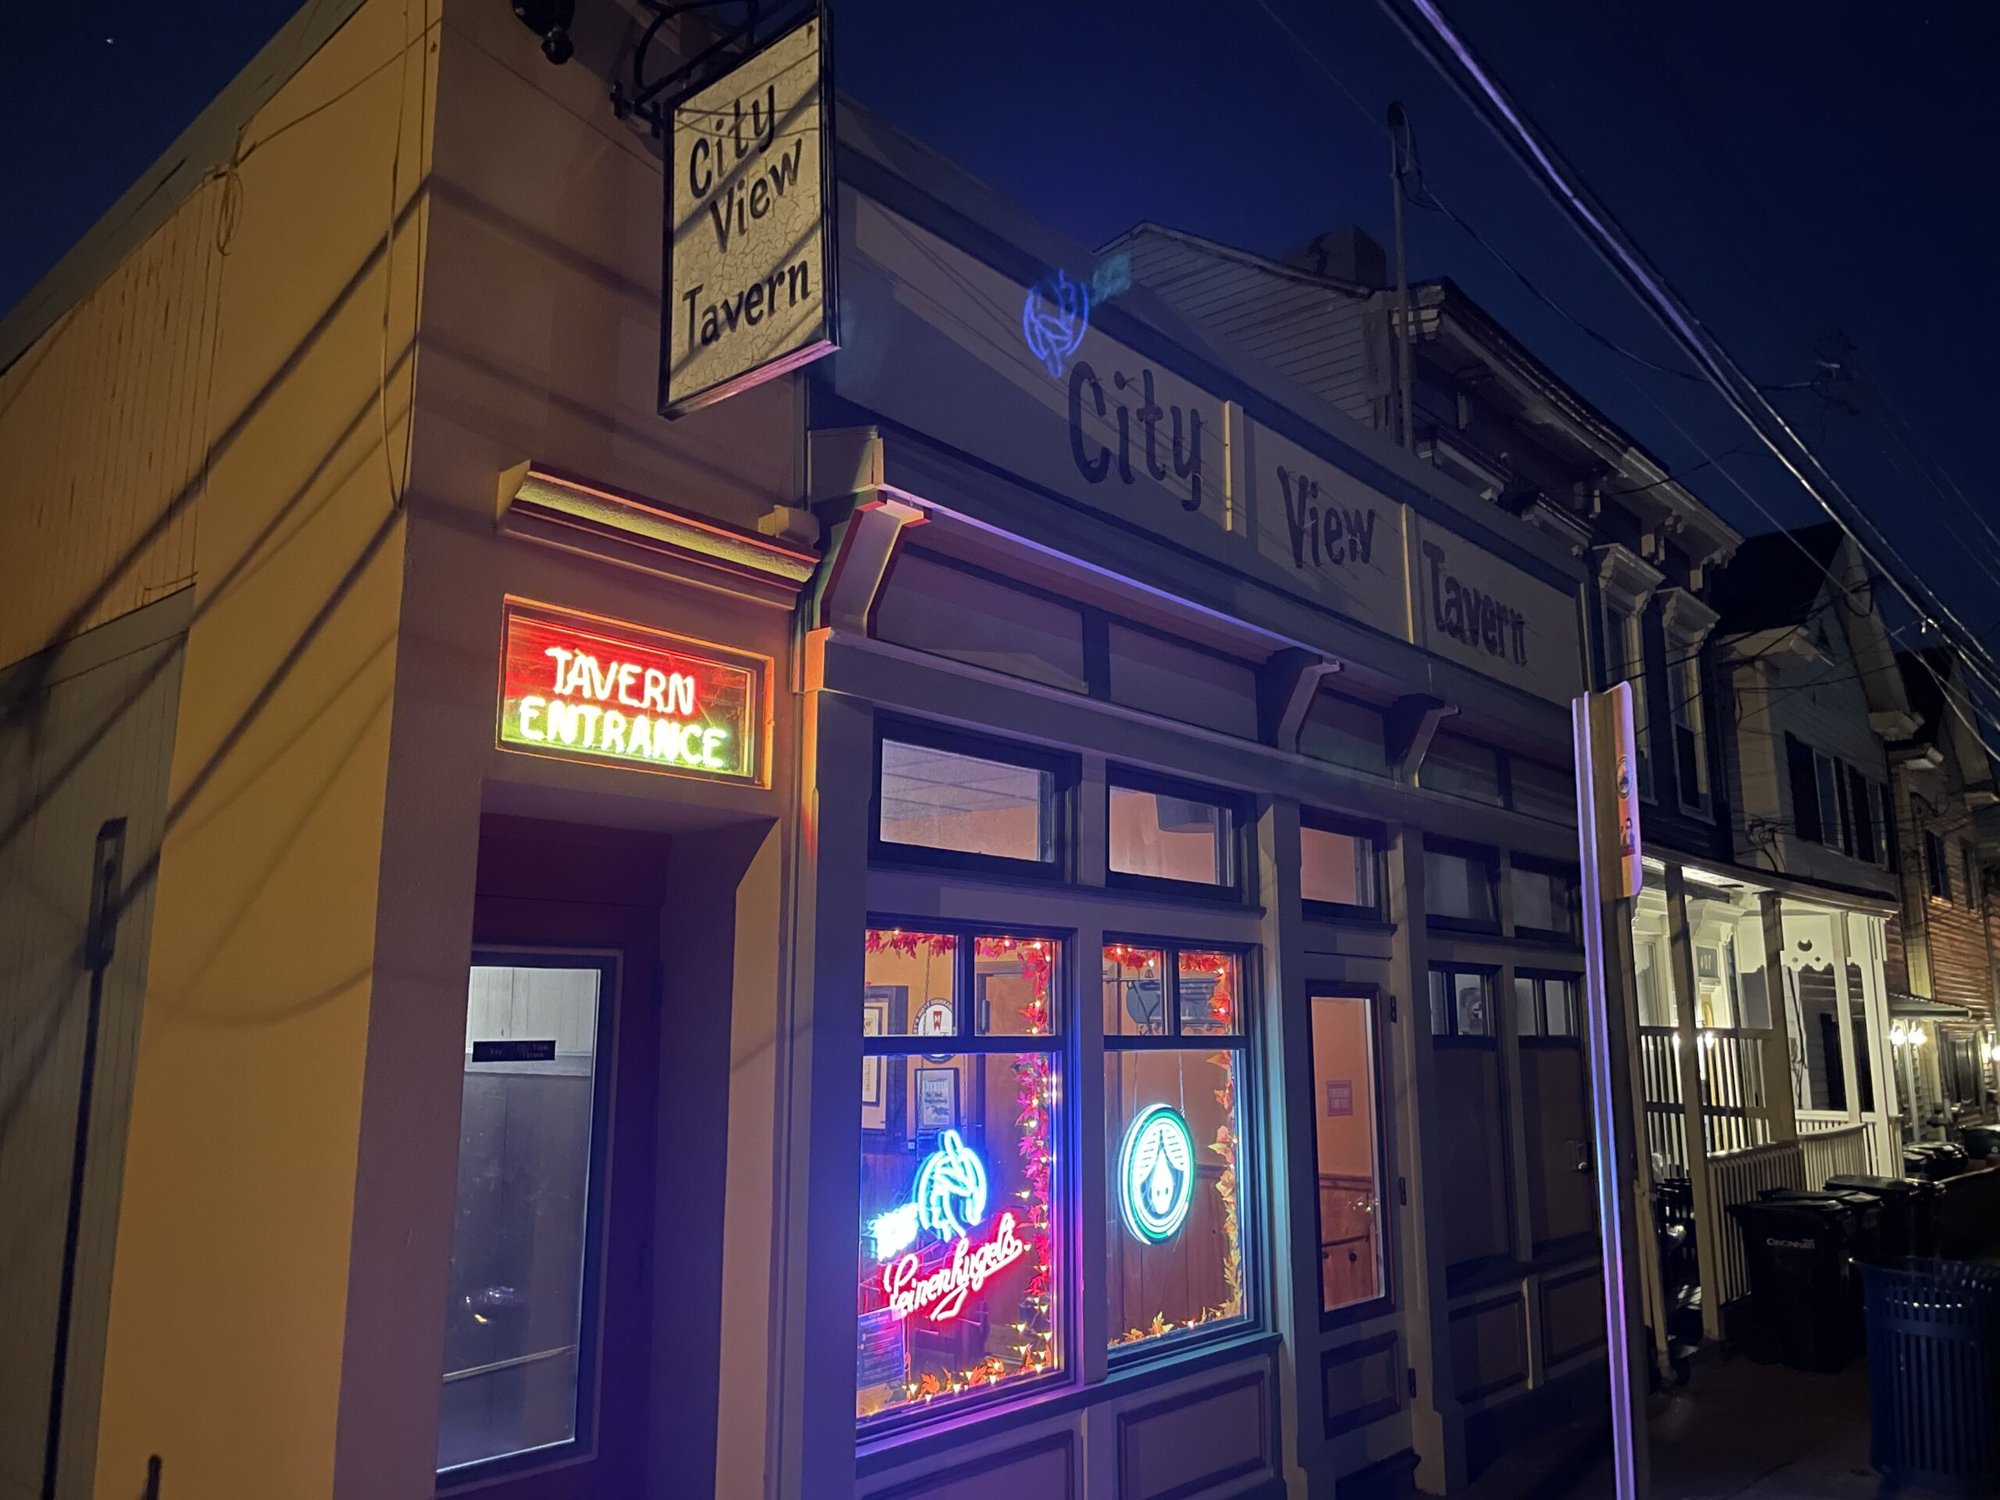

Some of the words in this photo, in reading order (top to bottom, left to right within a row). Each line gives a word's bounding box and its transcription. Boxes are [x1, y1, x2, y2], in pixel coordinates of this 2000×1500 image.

[689, 84, 775, 199] City
[709, 137, 803, 254] View
[682, 259, 811, 352] Tavern
[1068, 361, 1201, 512] City
[1276, 465, 1377, 569] View
[1422, 540, 1527, 667] Tavern
[518, 695, 728, 767] ENTRANCE
[545, 646, 696, 716] TAVERN
